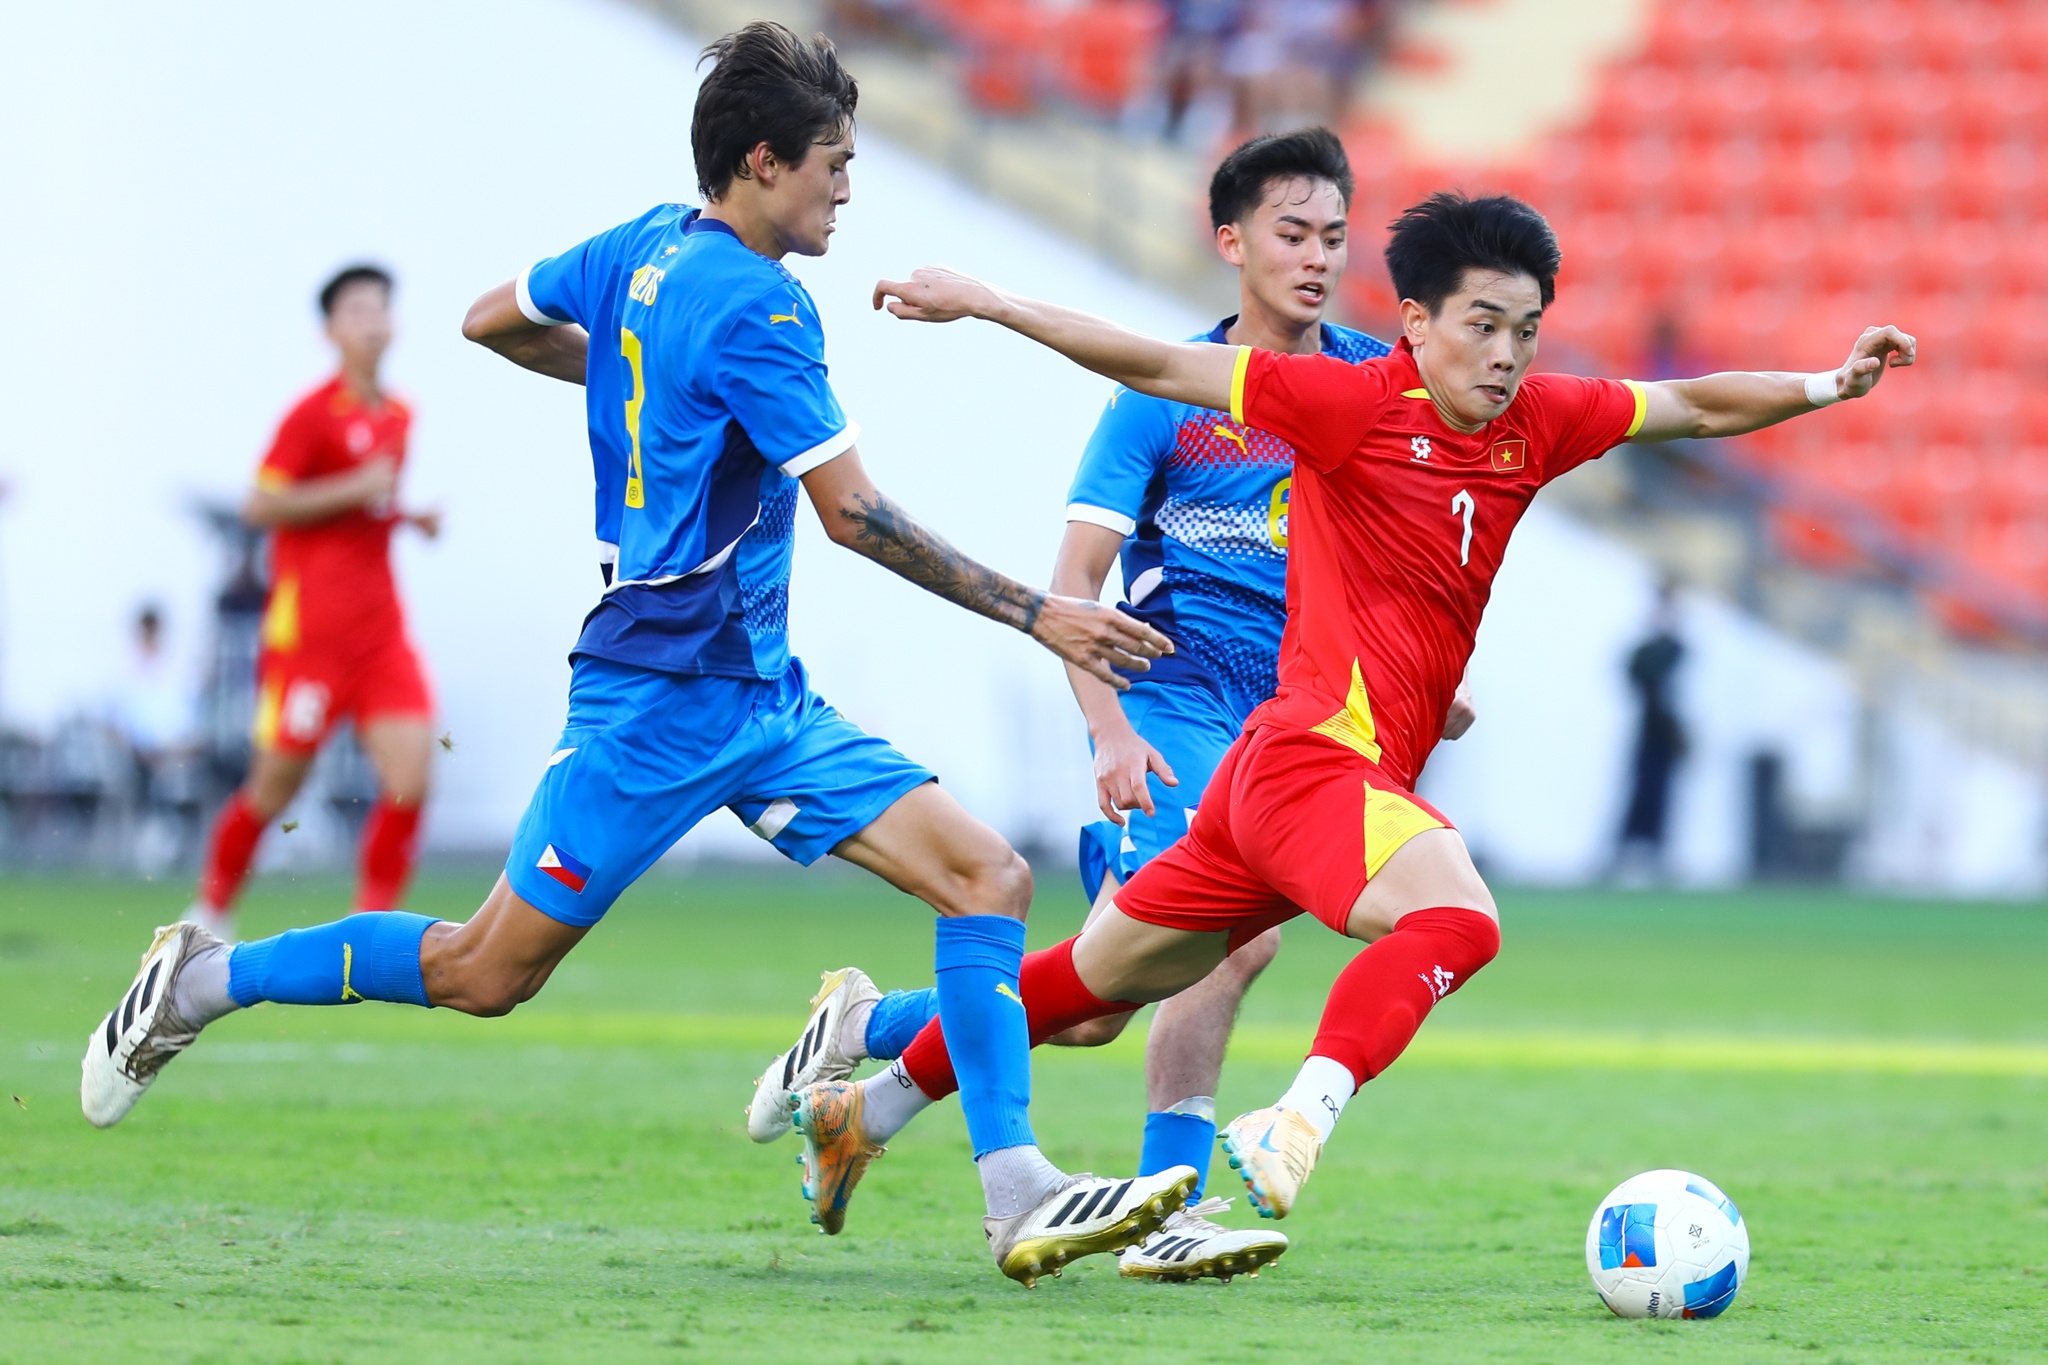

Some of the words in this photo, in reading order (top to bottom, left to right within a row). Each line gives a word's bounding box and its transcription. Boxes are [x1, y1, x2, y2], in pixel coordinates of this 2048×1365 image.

[621, 327, 645, 508] 3
[1451, 488, 1475, 567] 7
[1647, 1291, 1661, 1318] olten
